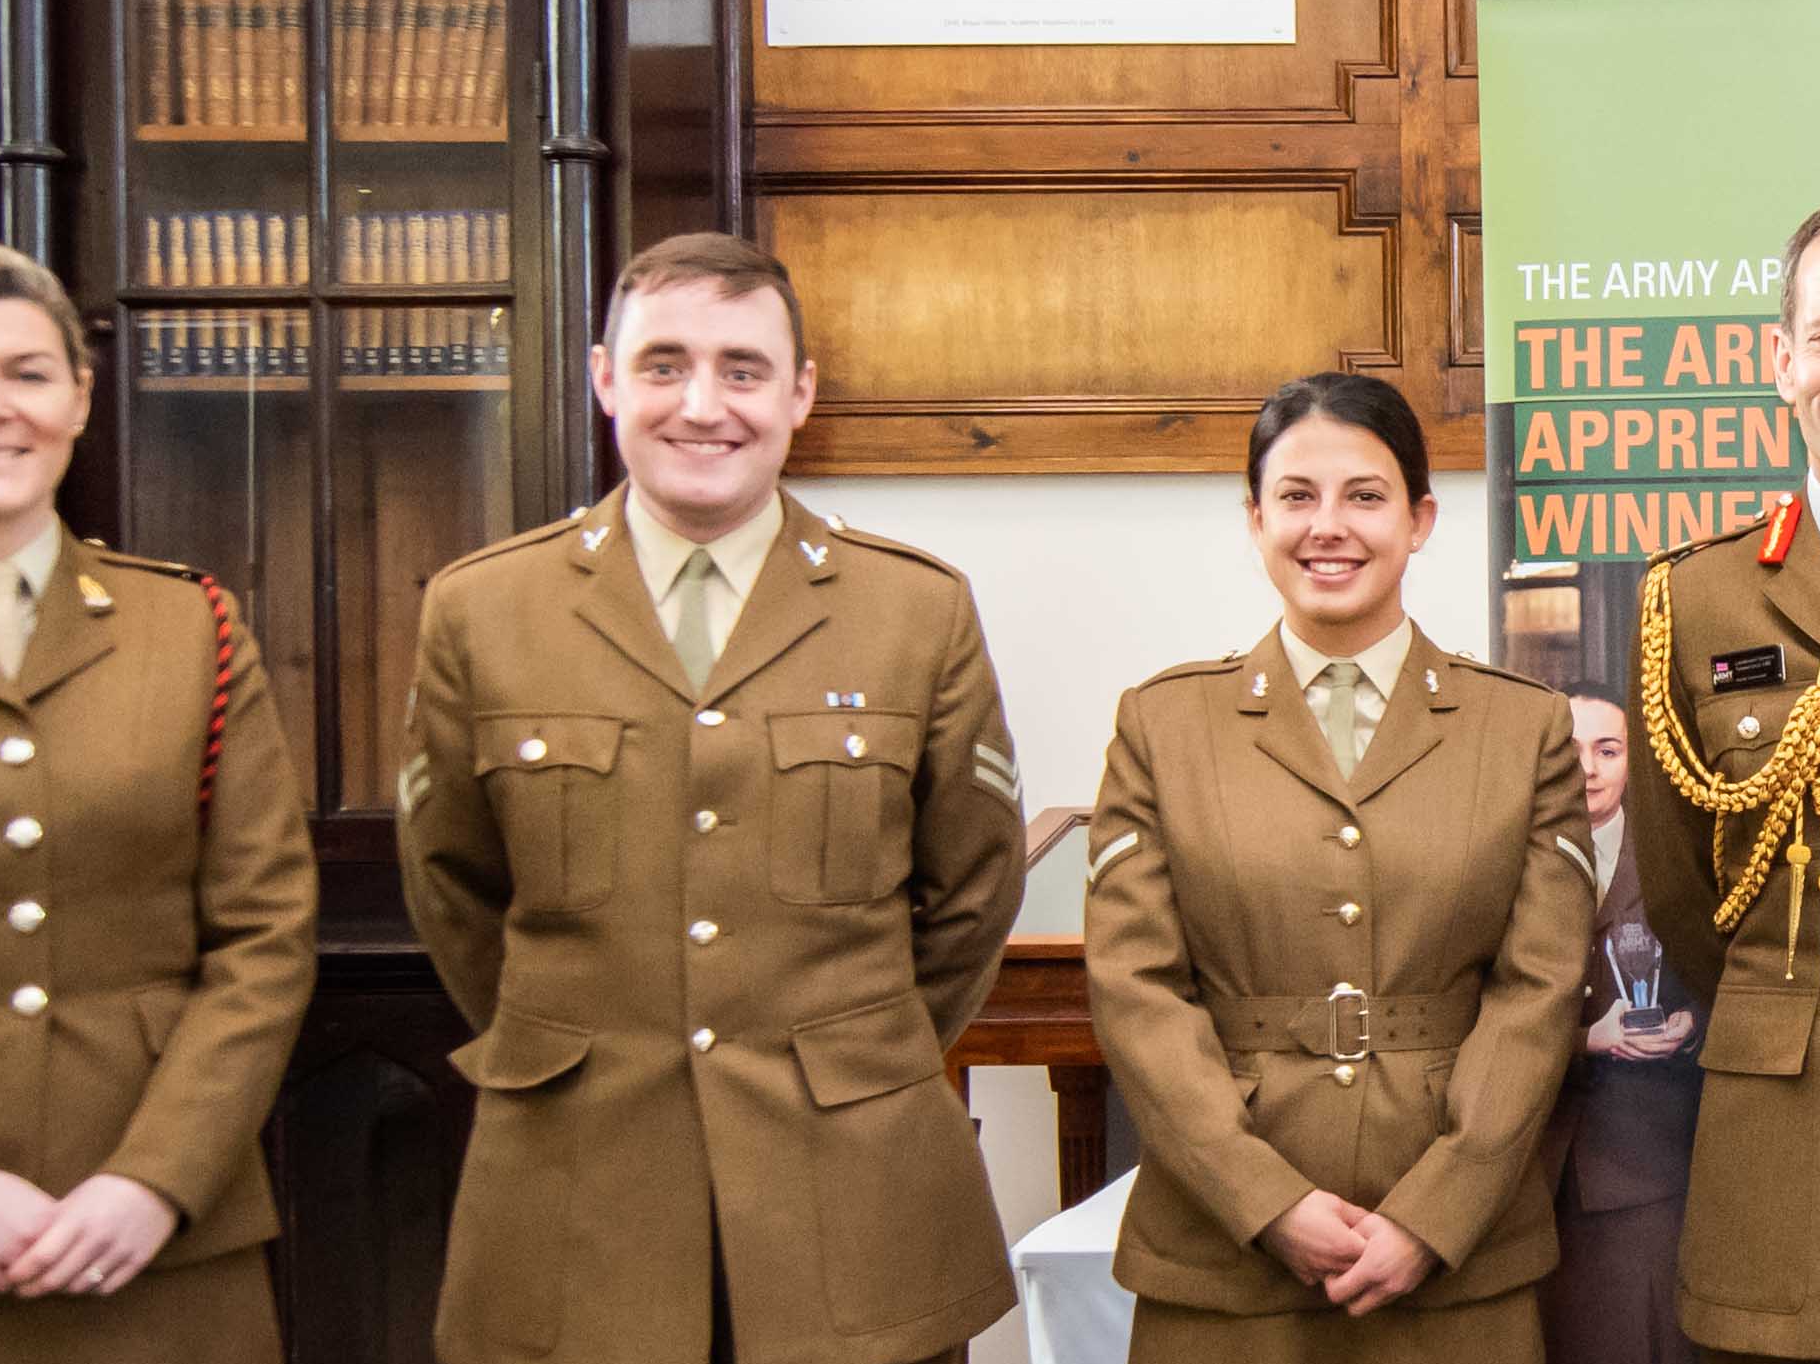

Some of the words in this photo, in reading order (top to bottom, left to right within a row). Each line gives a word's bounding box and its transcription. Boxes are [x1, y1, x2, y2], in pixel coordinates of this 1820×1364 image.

[1518, 263, 1590, 301] THE
[1602, 259, 1718, 299] ARMY
[1518, 327, 1645, 390] THE
[1664, 323, 1779, 386] AR
[1519, 406, 1795, 473] APPREN
[1521, 491, 1780, 556] WINNE
